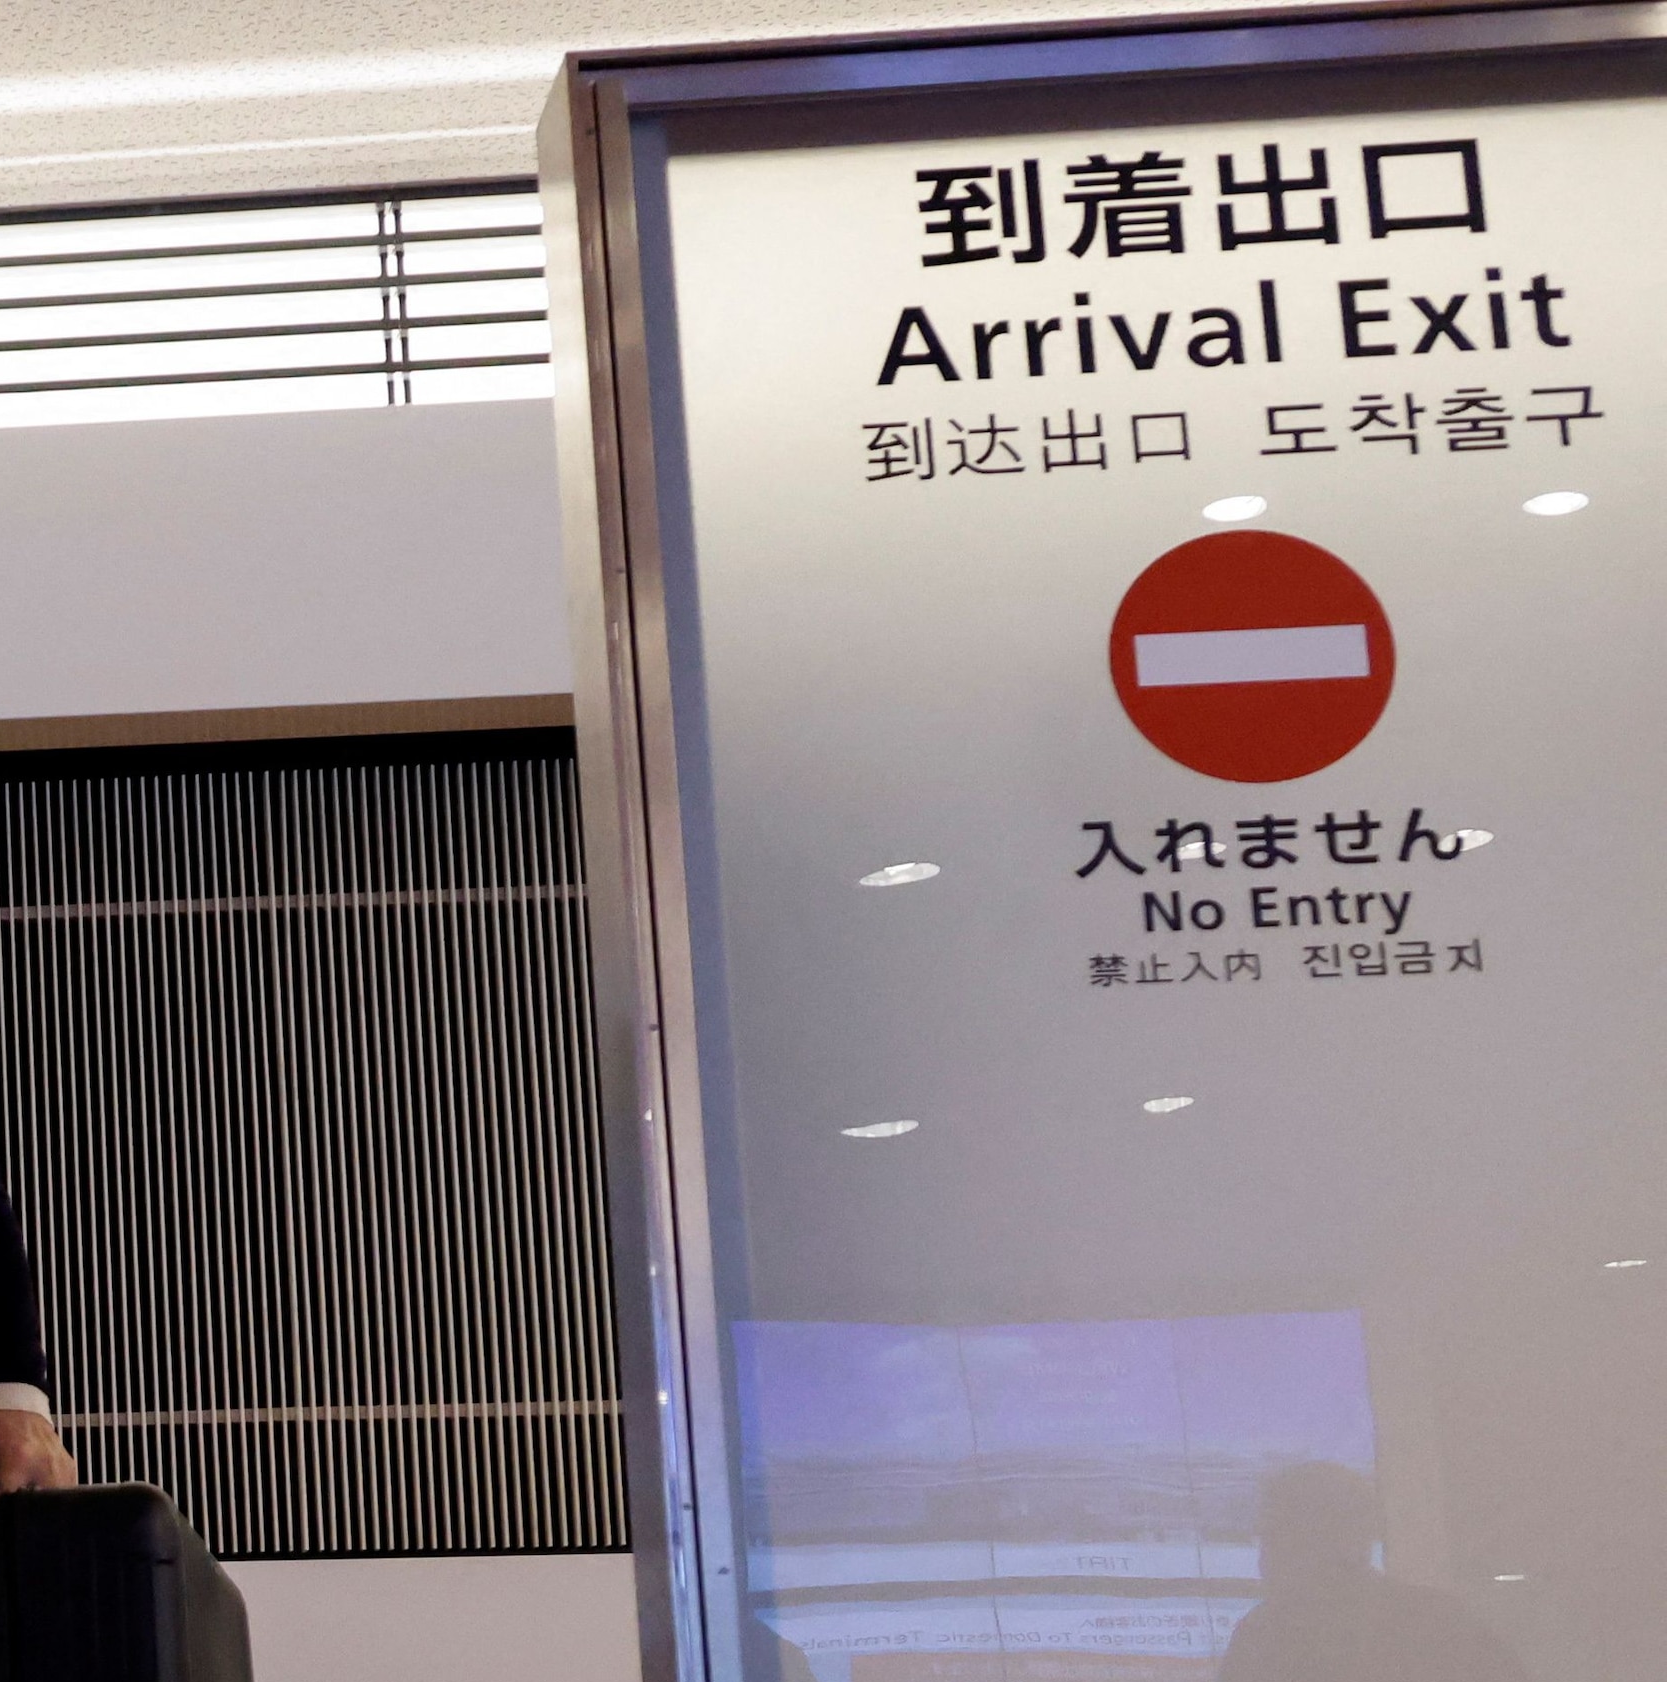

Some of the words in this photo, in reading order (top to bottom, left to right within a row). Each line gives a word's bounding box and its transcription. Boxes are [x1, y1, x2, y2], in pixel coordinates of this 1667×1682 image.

[912, 136, 1486, 267] 到着出口
[878, 280, 1281, 385] Arrival
[1339, 268, 1570, 357] Exit
[863, 410, 1190, 481] 到达出口
[1261, 387, 1603, 455] 도착출구
[1076, 809, 1461, 878] 入れません
[1144, 891, 1223, 932] No
[1251, 887, 1410, 934] Entry
[1090, 952, 1260, 987] 禁止入内
[1304, 939, 1481, 977] 진입금지
